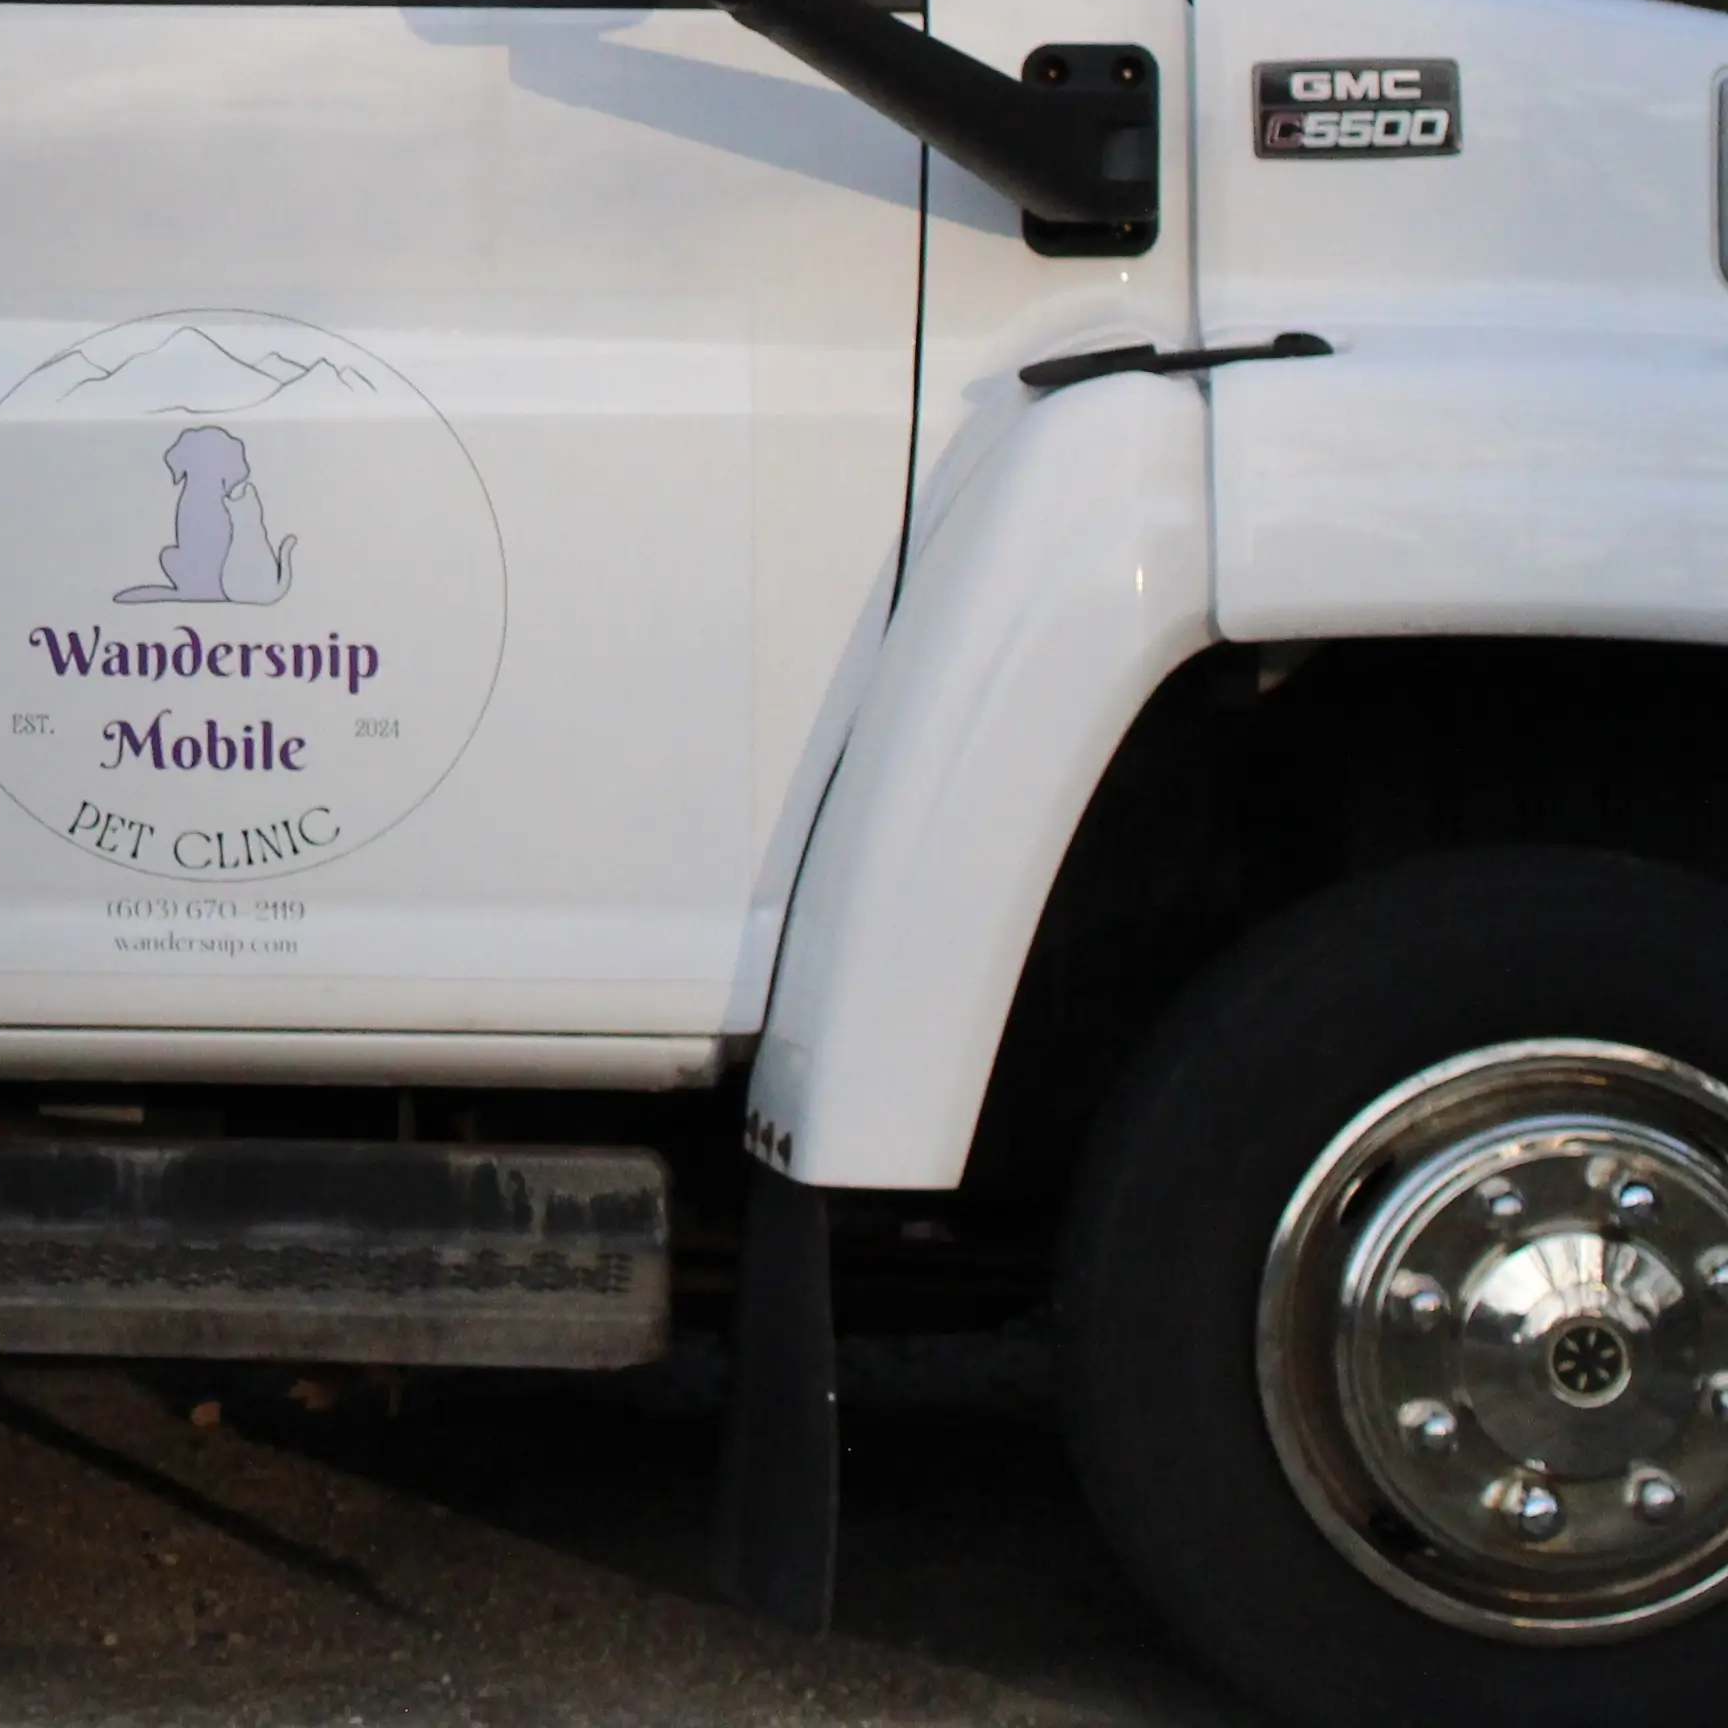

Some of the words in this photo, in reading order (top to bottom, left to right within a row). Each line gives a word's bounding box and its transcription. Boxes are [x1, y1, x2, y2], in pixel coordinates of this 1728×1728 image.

[1290, 70, 1422, 101] GMC
[1265, 109, 1451, 149] C5500
[29, 625, 380, 695] Wandersnip
[11, 713, 56, 735] EST.
[99, 709, 308, 771] Mobile
[67, 799, 155, 860] PET
[172, 806, 341, 870] CLINIC
[106, 897, 178, 921] (603)
